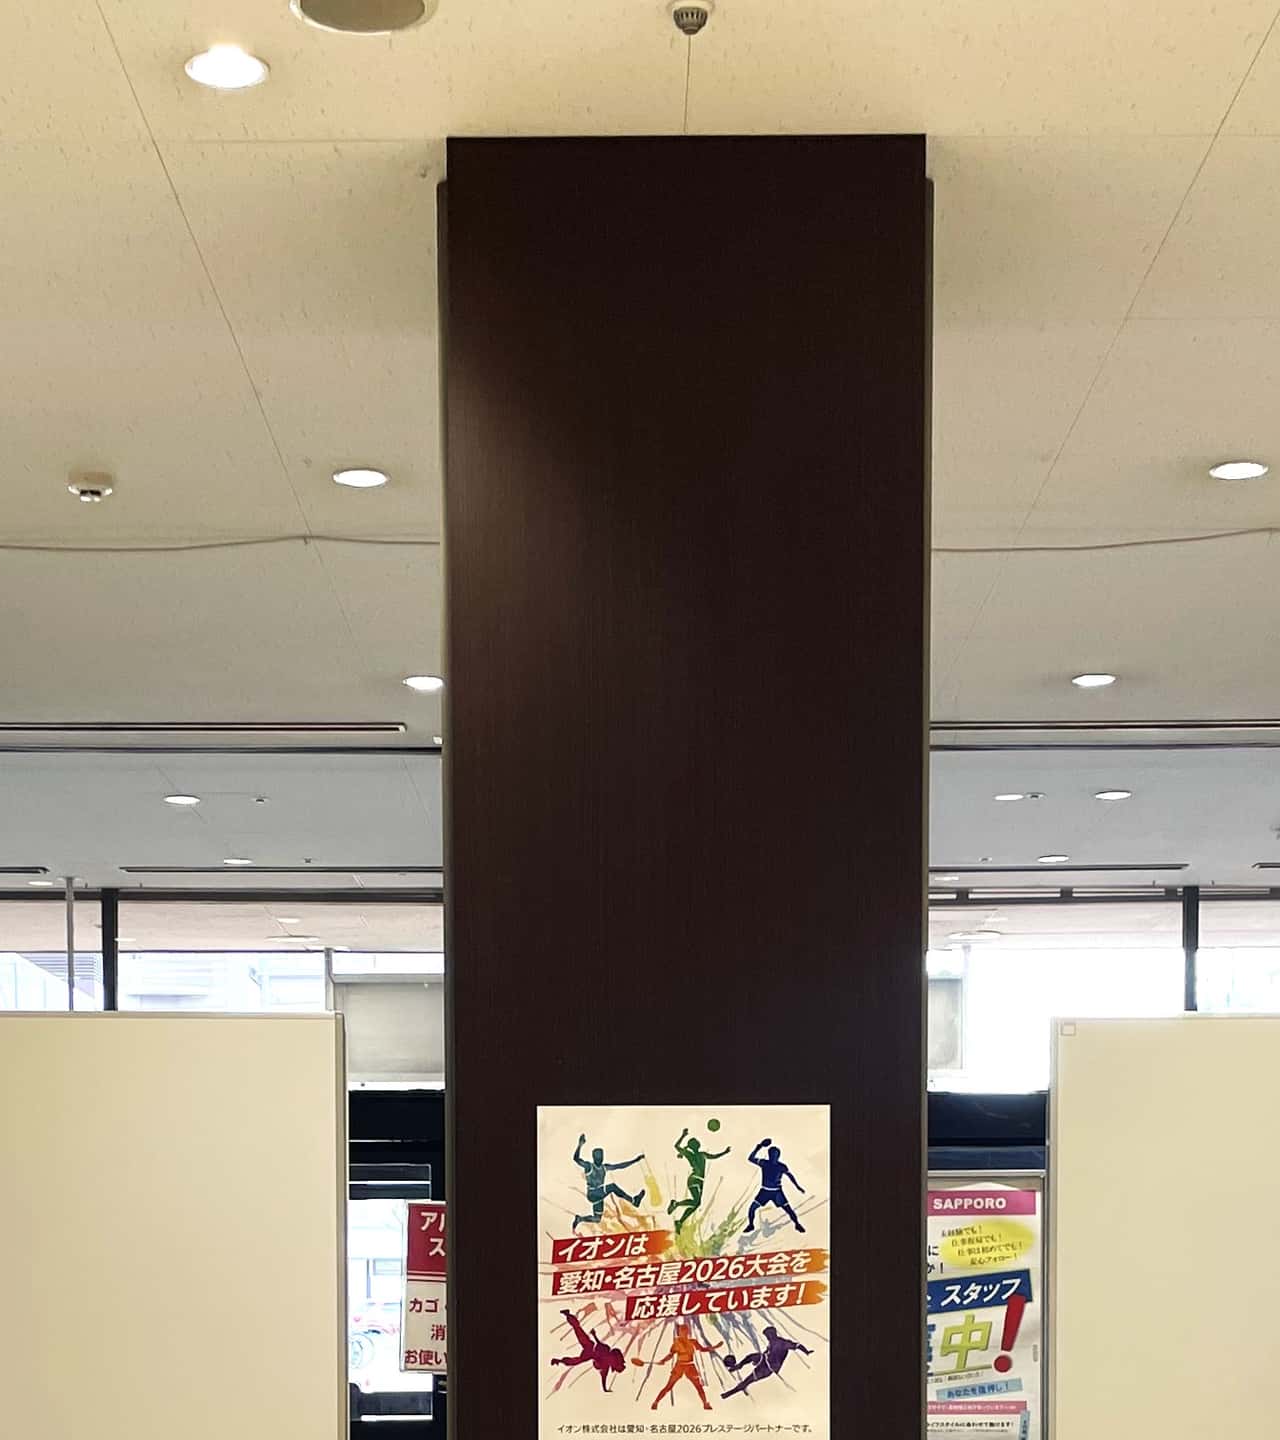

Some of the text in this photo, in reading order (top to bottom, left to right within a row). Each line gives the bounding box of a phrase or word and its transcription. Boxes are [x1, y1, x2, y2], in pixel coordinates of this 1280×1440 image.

[933, 1198, 1007, 1210] SAPPORO
[558, 1235, 648, 1263] イオンは
[557, 1250, 812, 1295] 愛知・名古屋2026大会を
[631, 1282, 806, 1320] 応援しています！
[557, 1423, 813, 1434] イオン株式会社は愛知・名古屋2026プレステージパートナーです。
